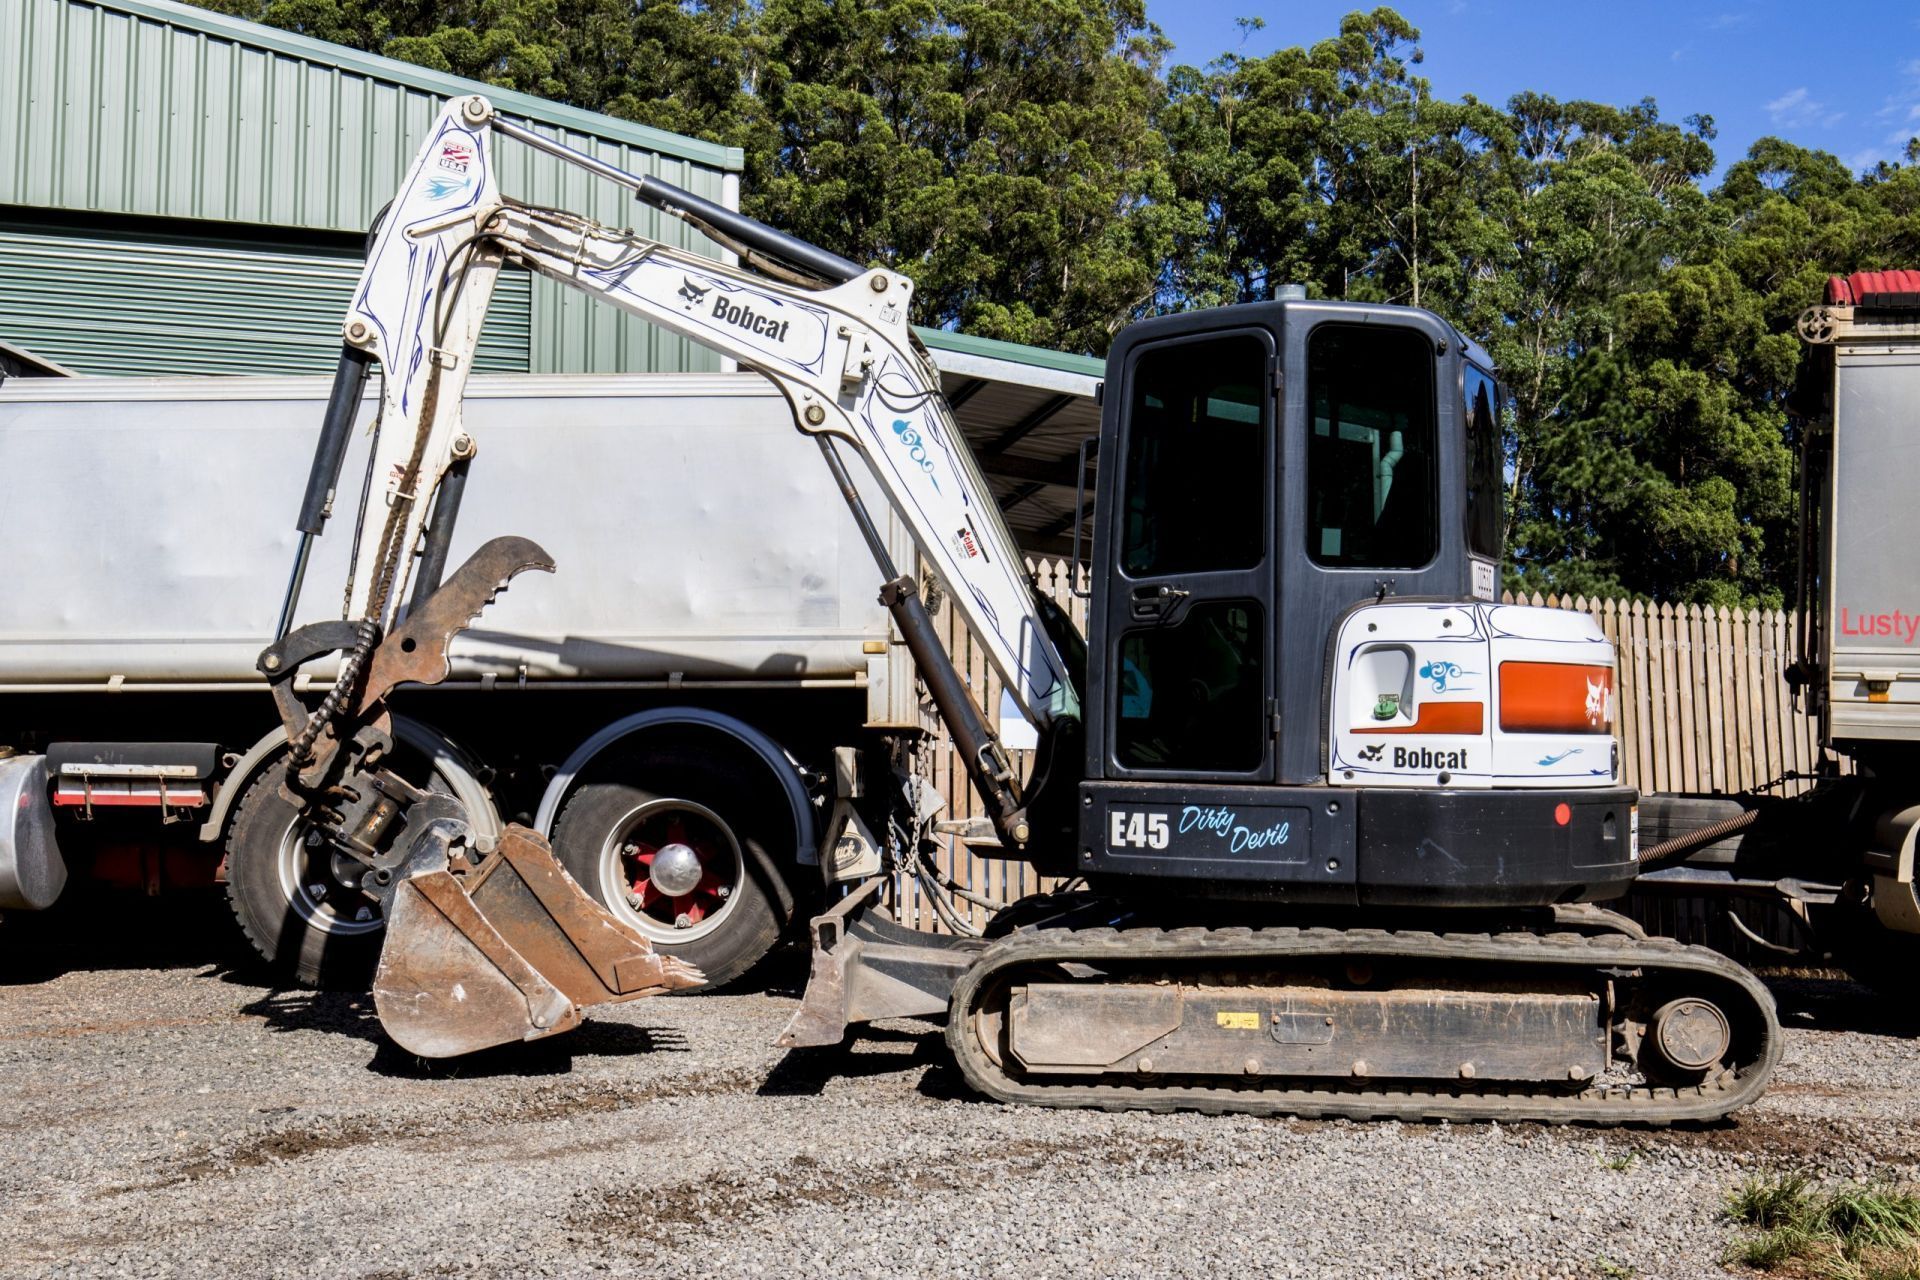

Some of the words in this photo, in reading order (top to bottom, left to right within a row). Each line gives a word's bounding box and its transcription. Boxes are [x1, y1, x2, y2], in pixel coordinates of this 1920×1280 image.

[440, 158, 467, 173] USA
[712, 295, 789, 343] Bobcat
[1842, 607, 1920, 645] Lusty
[1394, 746, 1467, 769] Bobcat
[1111, 811, 1170, 849] E45
[1179, 805, 1236, 837] Dirty
[1230, 822, 1290, 853] Devil
